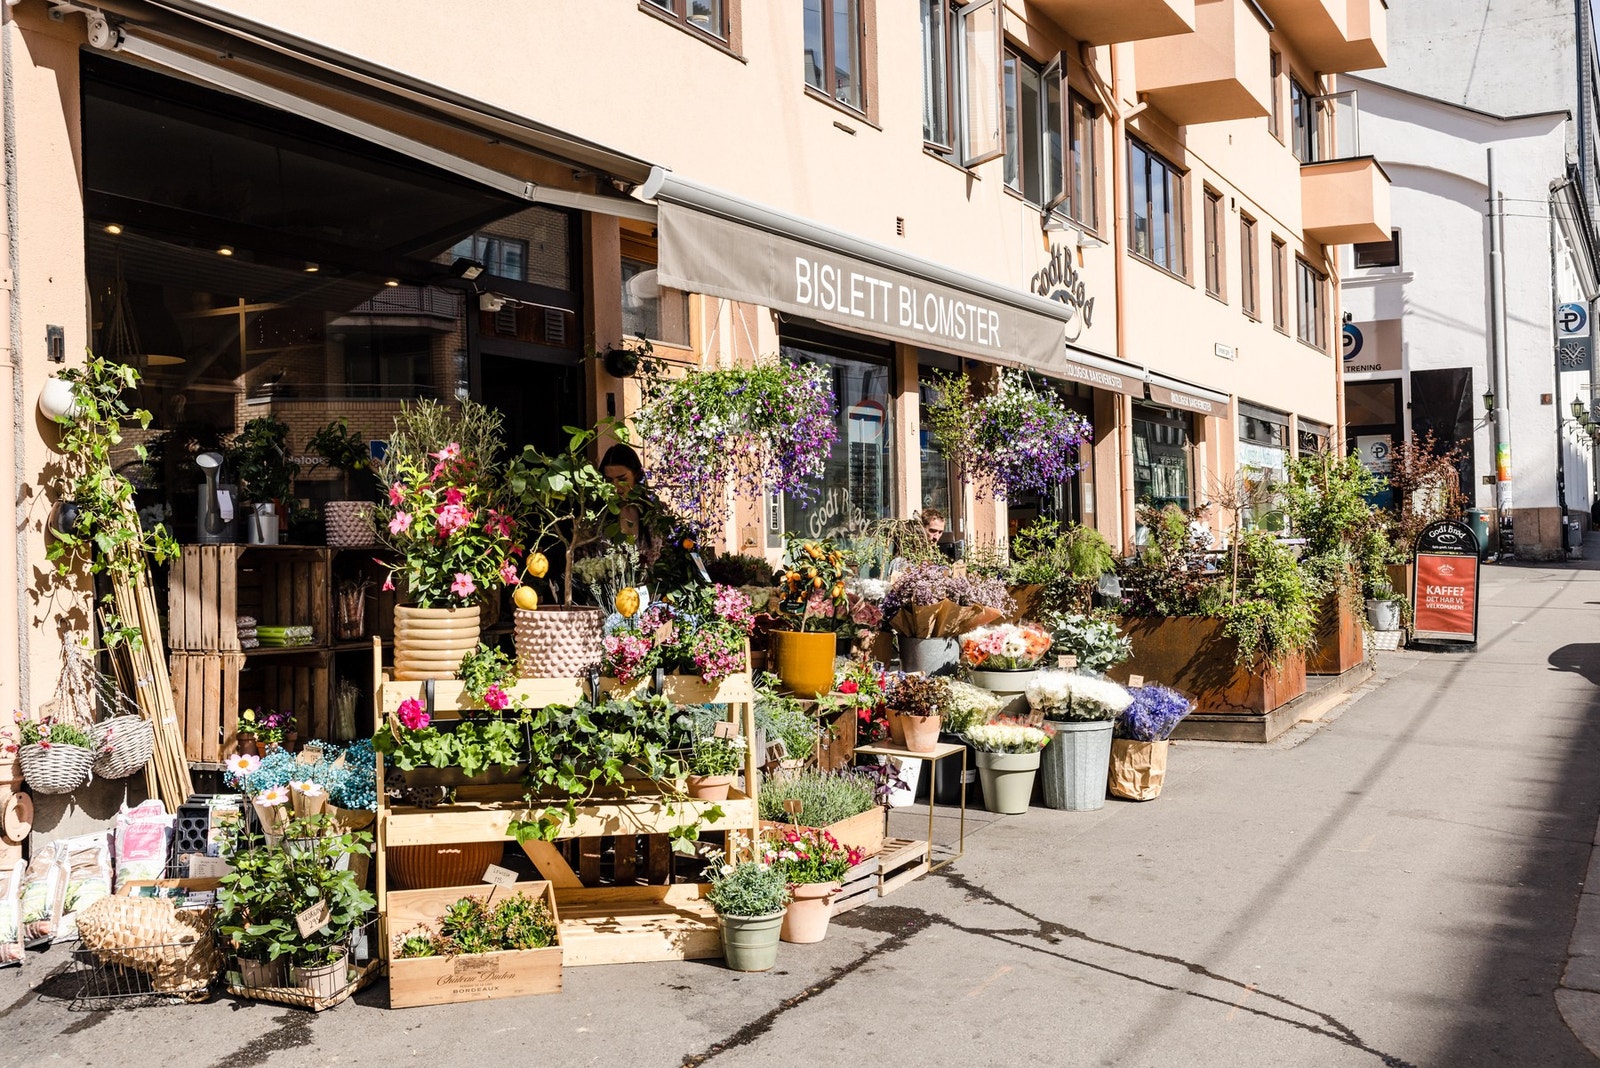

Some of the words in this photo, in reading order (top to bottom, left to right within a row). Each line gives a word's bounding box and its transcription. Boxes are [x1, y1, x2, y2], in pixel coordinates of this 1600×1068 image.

[1030, 241, 1063, 297] Godt
[1063, 245, 1095, 329] Brød
[795, 256, 893, 323] BISLETT
[898, 285, 1001, 348] BLOMSTER
[1346, 363, 1382, 373] TRENING
[809, 487, 839, 539] Godt
[1428, 525, 1447, 538] Godt
[1448, 525, 1467, 539] Brød
[1426, 585, 1465, 597] KAFFE?
[1426, 603, 1465, 611] VELKOMMEN!
[452, 986, 500, 994] BORDEAUX
